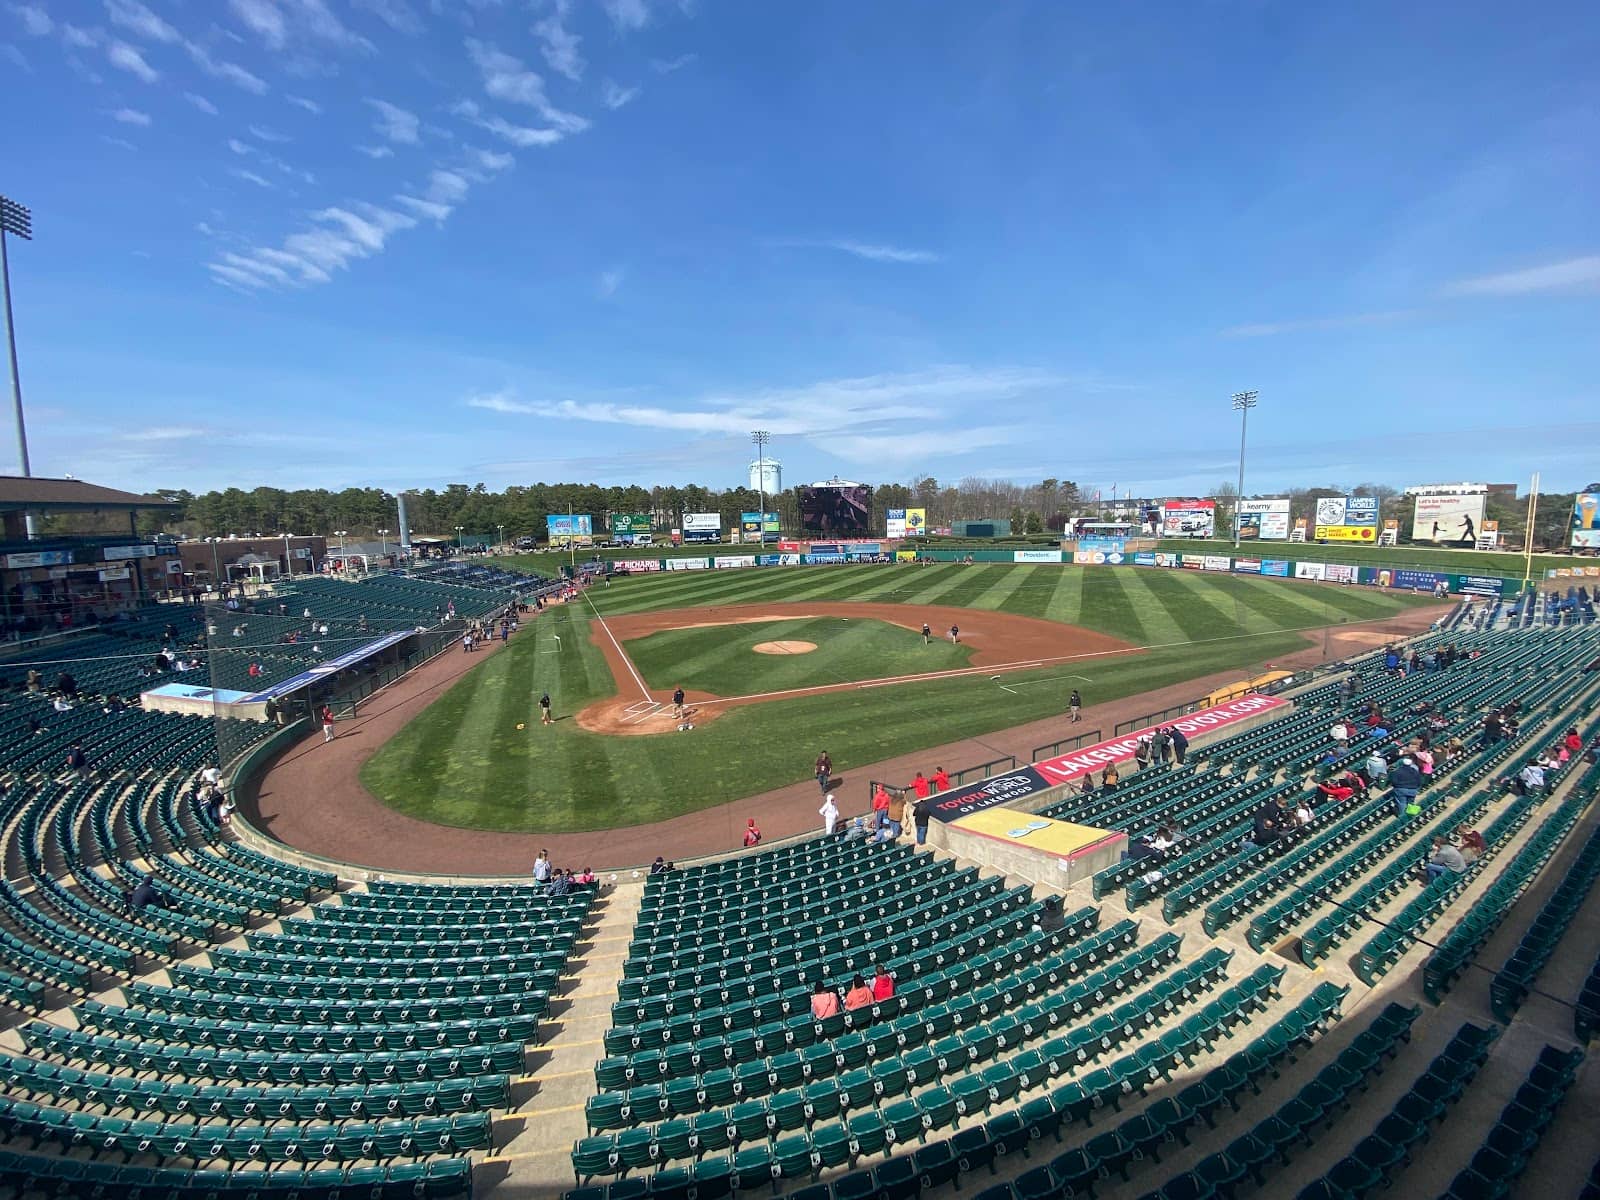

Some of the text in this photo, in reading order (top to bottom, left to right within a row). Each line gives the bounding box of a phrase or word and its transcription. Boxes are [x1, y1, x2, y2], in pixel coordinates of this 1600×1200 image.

[1246, 502, 1270, 511] kearny
[1045, 697, 1275, 776] LAKEWOOYOTA.COM
[936, 777, 1031, 811] TOYOTA WORLD
[960, 786, 1032, 813] OF LAKEWOOD
